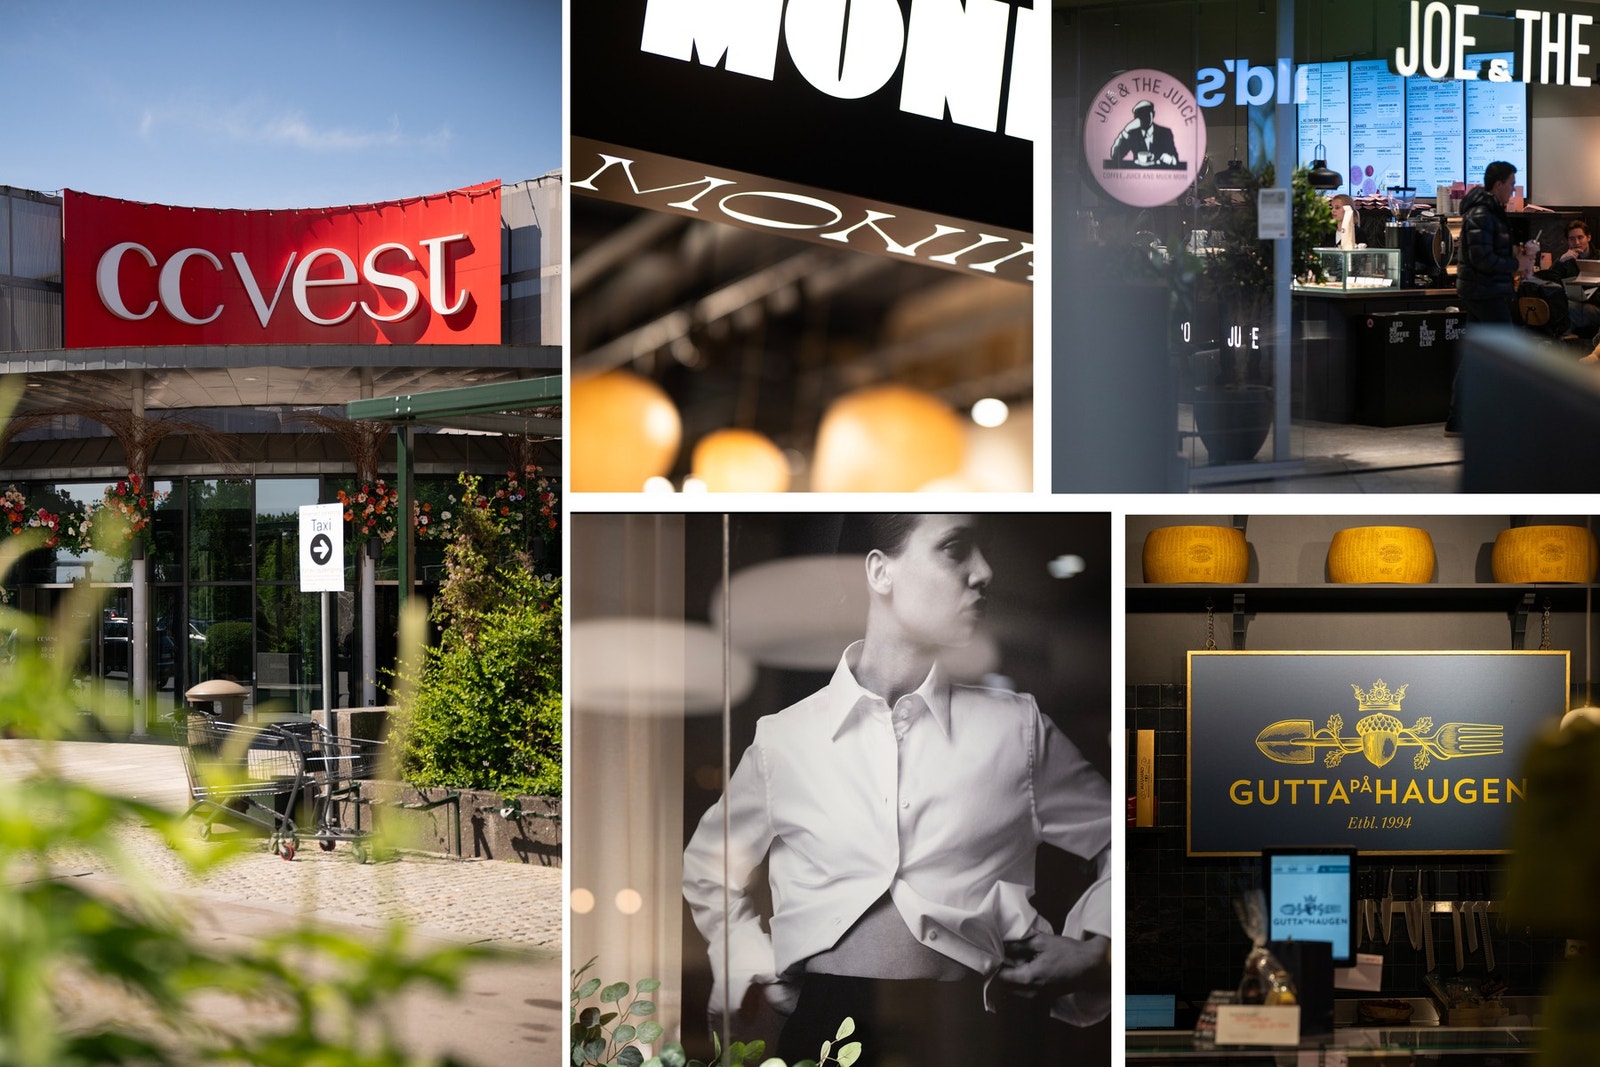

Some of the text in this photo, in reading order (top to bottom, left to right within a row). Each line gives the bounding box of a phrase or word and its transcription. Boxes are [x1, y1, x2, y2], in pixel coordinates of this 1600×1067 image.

[1395, 0, 1594, 87] JOE & THE
[1095, 77, 1197, 127] JOE & THE JUICE
[311, 518, 332, 531] Taxi
[1229, 775, 1528, 805] GUTTA PÅ HAUGEN
[1347, 816, 1412, 830] Etbl. 1994
[1309, 917, 1348, 926] HAUGEN
